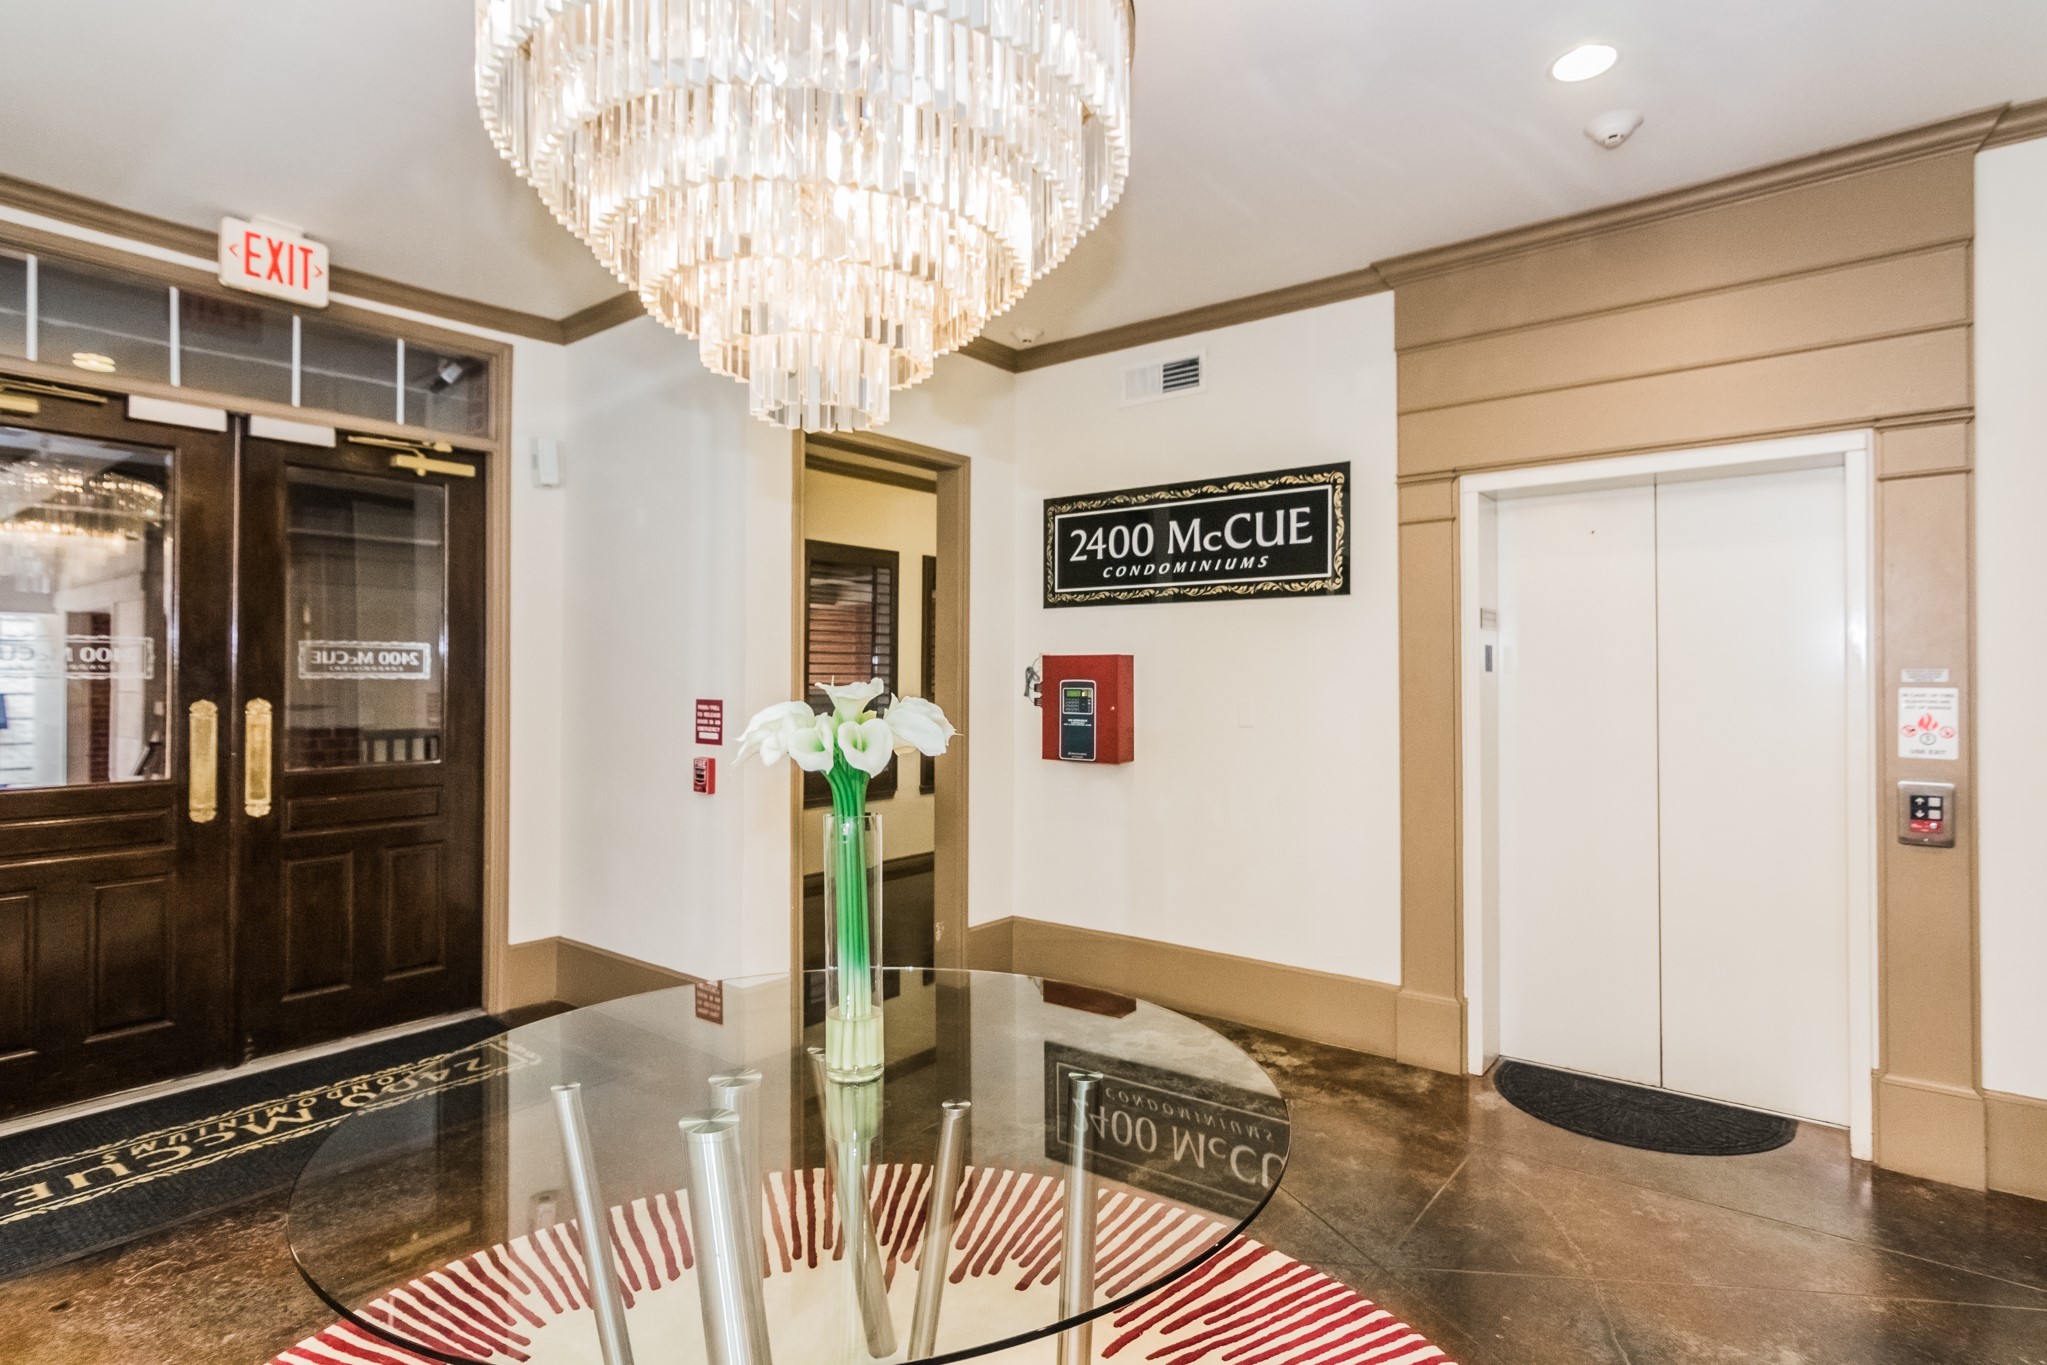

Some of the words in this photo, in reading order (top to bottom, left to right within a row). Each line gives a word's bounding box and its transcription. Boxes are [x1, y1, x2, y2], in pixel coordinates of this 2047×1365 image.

[243, 231, 314, 290] EXIT
[1069, 521, 1154, 562] 2400
[1167, 506, 1313, 555] McCUE
[1102, 555, 1269, 578] CONDOMINIUMS
